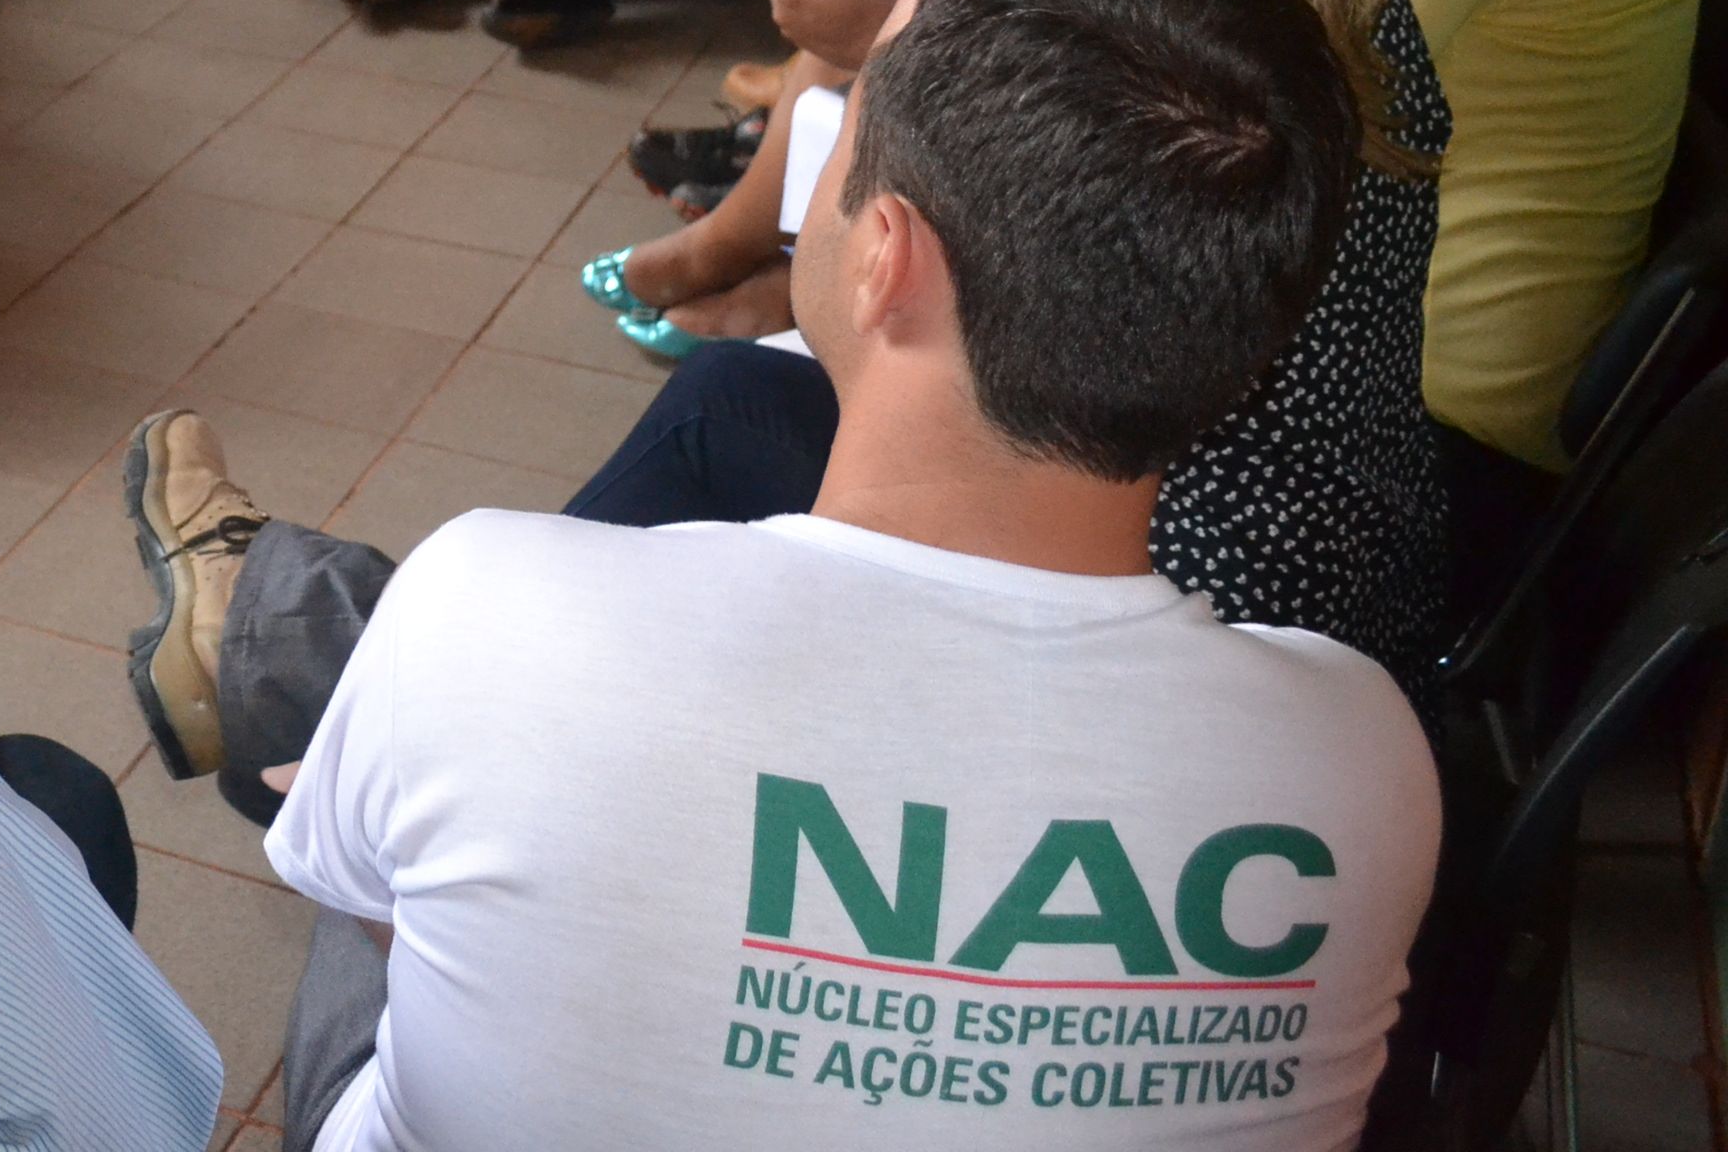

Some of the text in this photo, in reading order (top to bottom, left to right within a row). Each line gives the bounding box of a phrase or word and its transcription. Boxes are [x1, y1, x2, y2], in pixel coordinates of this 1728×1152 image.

[745, 772, 1336, 978] NAC
[735, 961, 1308, 1046] NÚCLEO ESPECIALIZADO
[723, 1021, 1300, 1108] DE AÇÕES COLETIVAS
